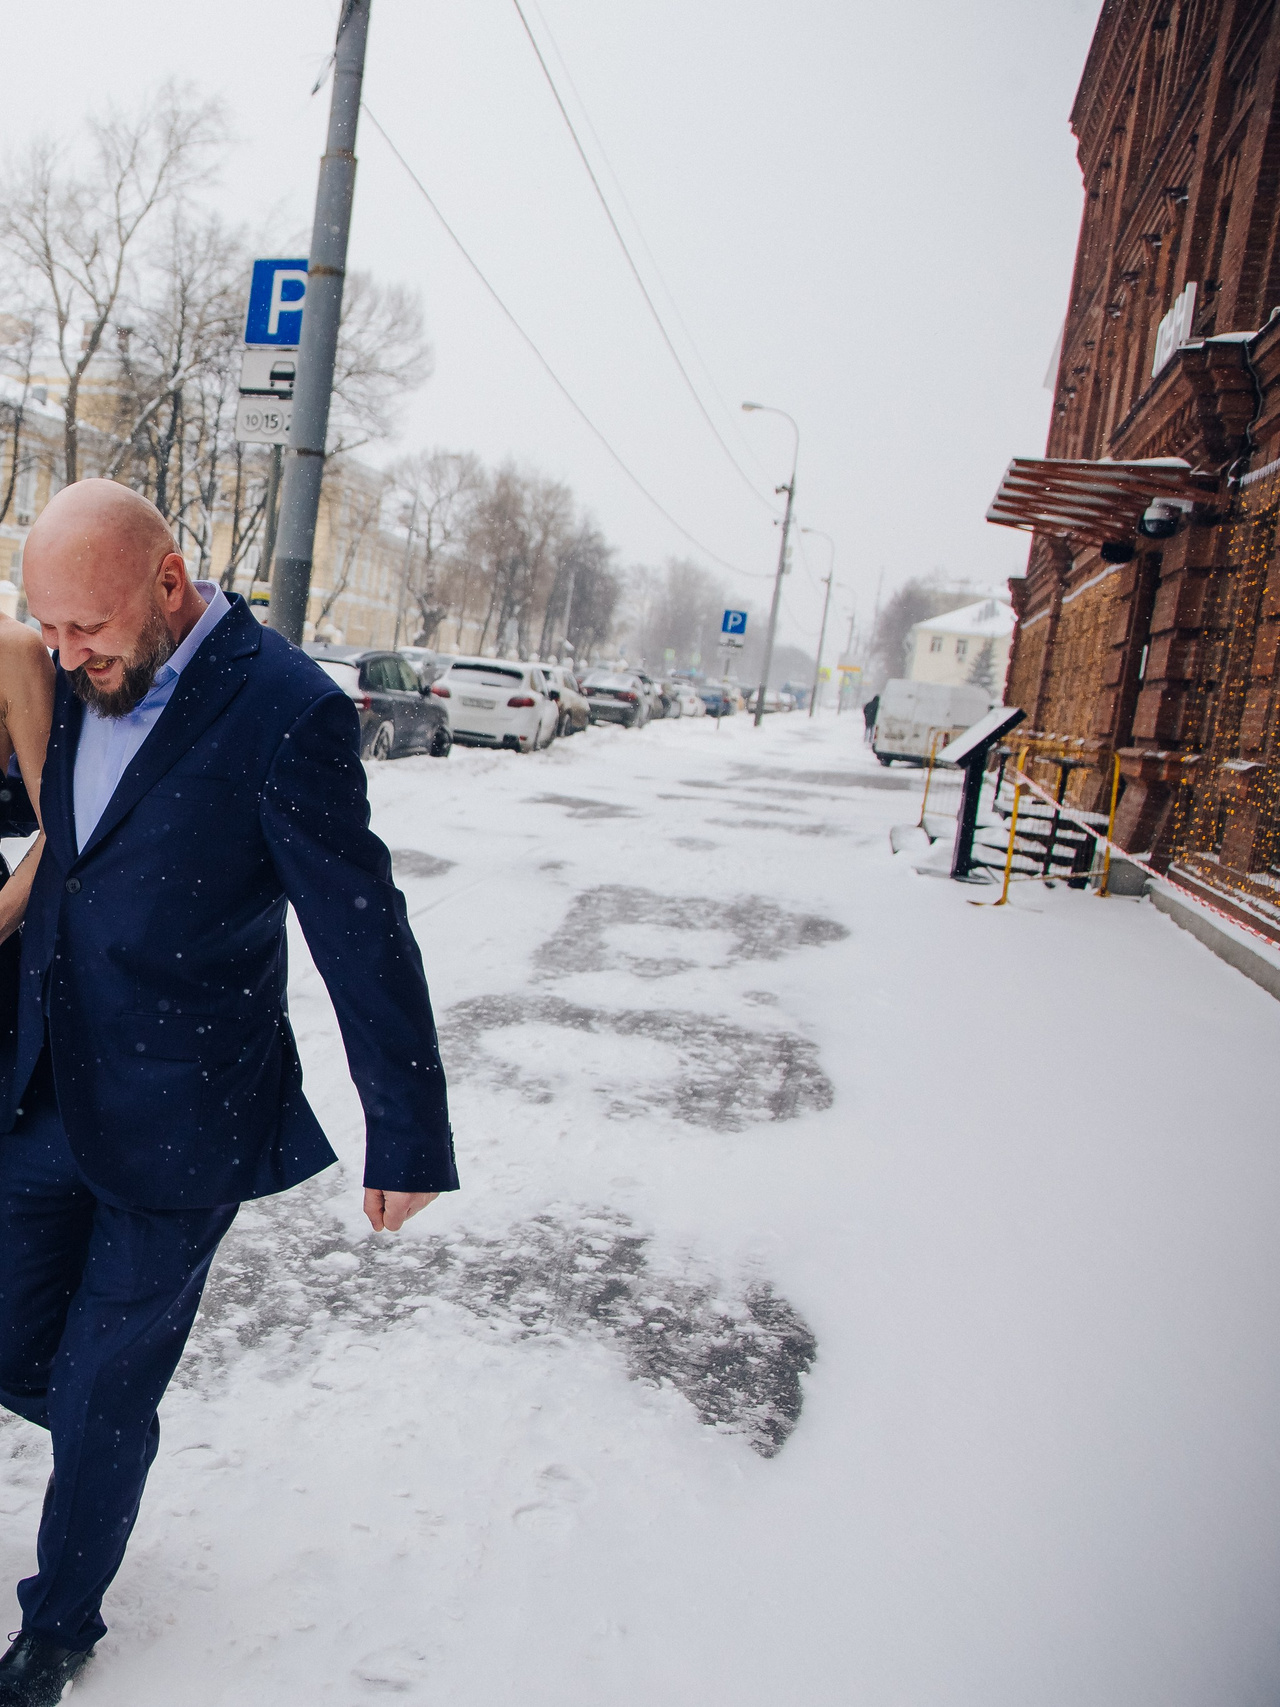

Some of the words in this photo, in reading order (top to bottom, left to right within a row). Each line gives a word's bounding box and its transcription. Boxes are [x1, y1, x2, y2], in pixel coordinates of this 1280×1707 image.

[267, 269, 308, 335] P
[245, 414, 259, 426] 10
[264, 414, 279, 429] 15
[727, 612, 743, 630] P
